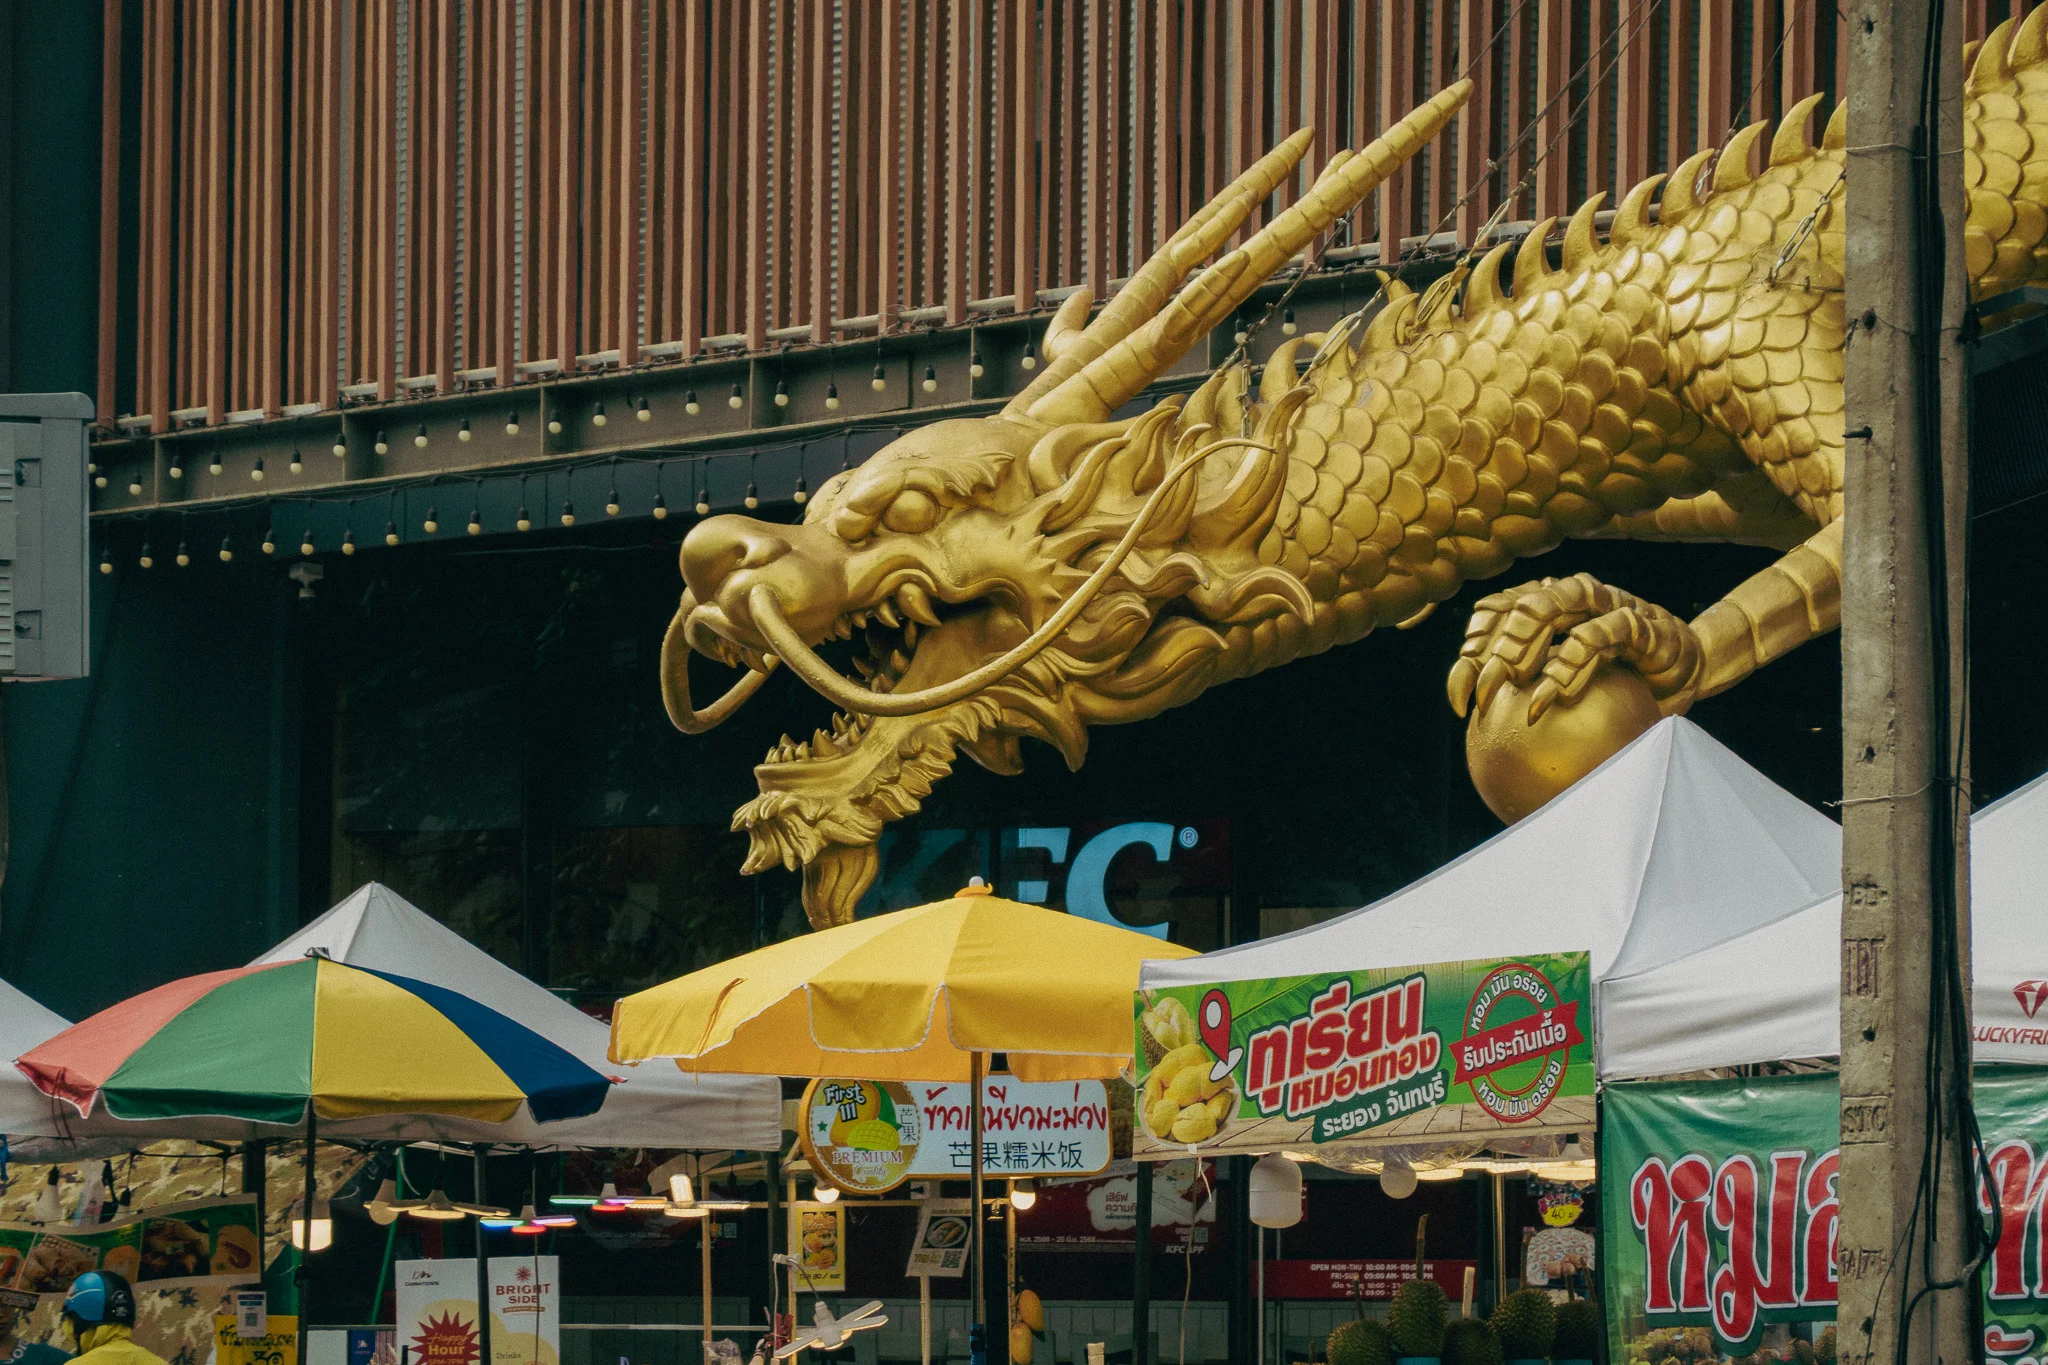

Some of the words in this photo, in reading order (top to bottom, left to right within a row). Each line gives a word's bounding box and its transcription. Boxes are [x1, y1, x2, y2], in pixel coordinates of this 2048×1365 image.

[1470, 992, 1492, 1032] หอม
[1491, 974, 1511, 997] มัน
[1513, 972, 1549, 1004] อร่อย
[1246, 976, 1426, 1114] ทุเรียน
[1463, 1010, 1568, 1072] รับประกันเนื้อ
[1287, 1032, 1440, 1117] หมอนทอง
[1477, 1081, 1506, 1114] หอม
[1508, 1096, 1530, 1117] มัน
[1531, 1059, 1562, 1107] อร่อย
[824, 1080, 866, 1106] First
[1322, 1102, 1382, 1137] ระยอง
[1387, 1071, 1446, 1116] จันทบุรี
[923, 1082, 1107, 1133] ข้าวเนียวมะม่วง
[899, 1107, 917, 1142] 芒果
[832, 1151, 903, 1165] PREMIUM
[948, 1141, 1085, 1169] 芒果糯米饭
[1165, 1245, 1185, 1254] KFC
[1311, 1263, 1330, 1271] OPEN
[1331, 1263, 1362, 1271] MON-THU
[1365, 1263, 1385, 1271] 10:00
[1400, 1263, 1417, 1271] 09:0
[1423, 1263, 1434, 1271] PM
[1364, 1272, 1385, 1280] 09:00
[1402, 1272, 1417, 1280] 10:0
[1423, 1272, 1434, 1280] PM
[495, 1283, 551, 1296] BRIGHT
[508, 1295, 539, 1304] SIDE
[427, 1332, 470, 1346] Happy
[428, 1344, 466, 1355] Hour
